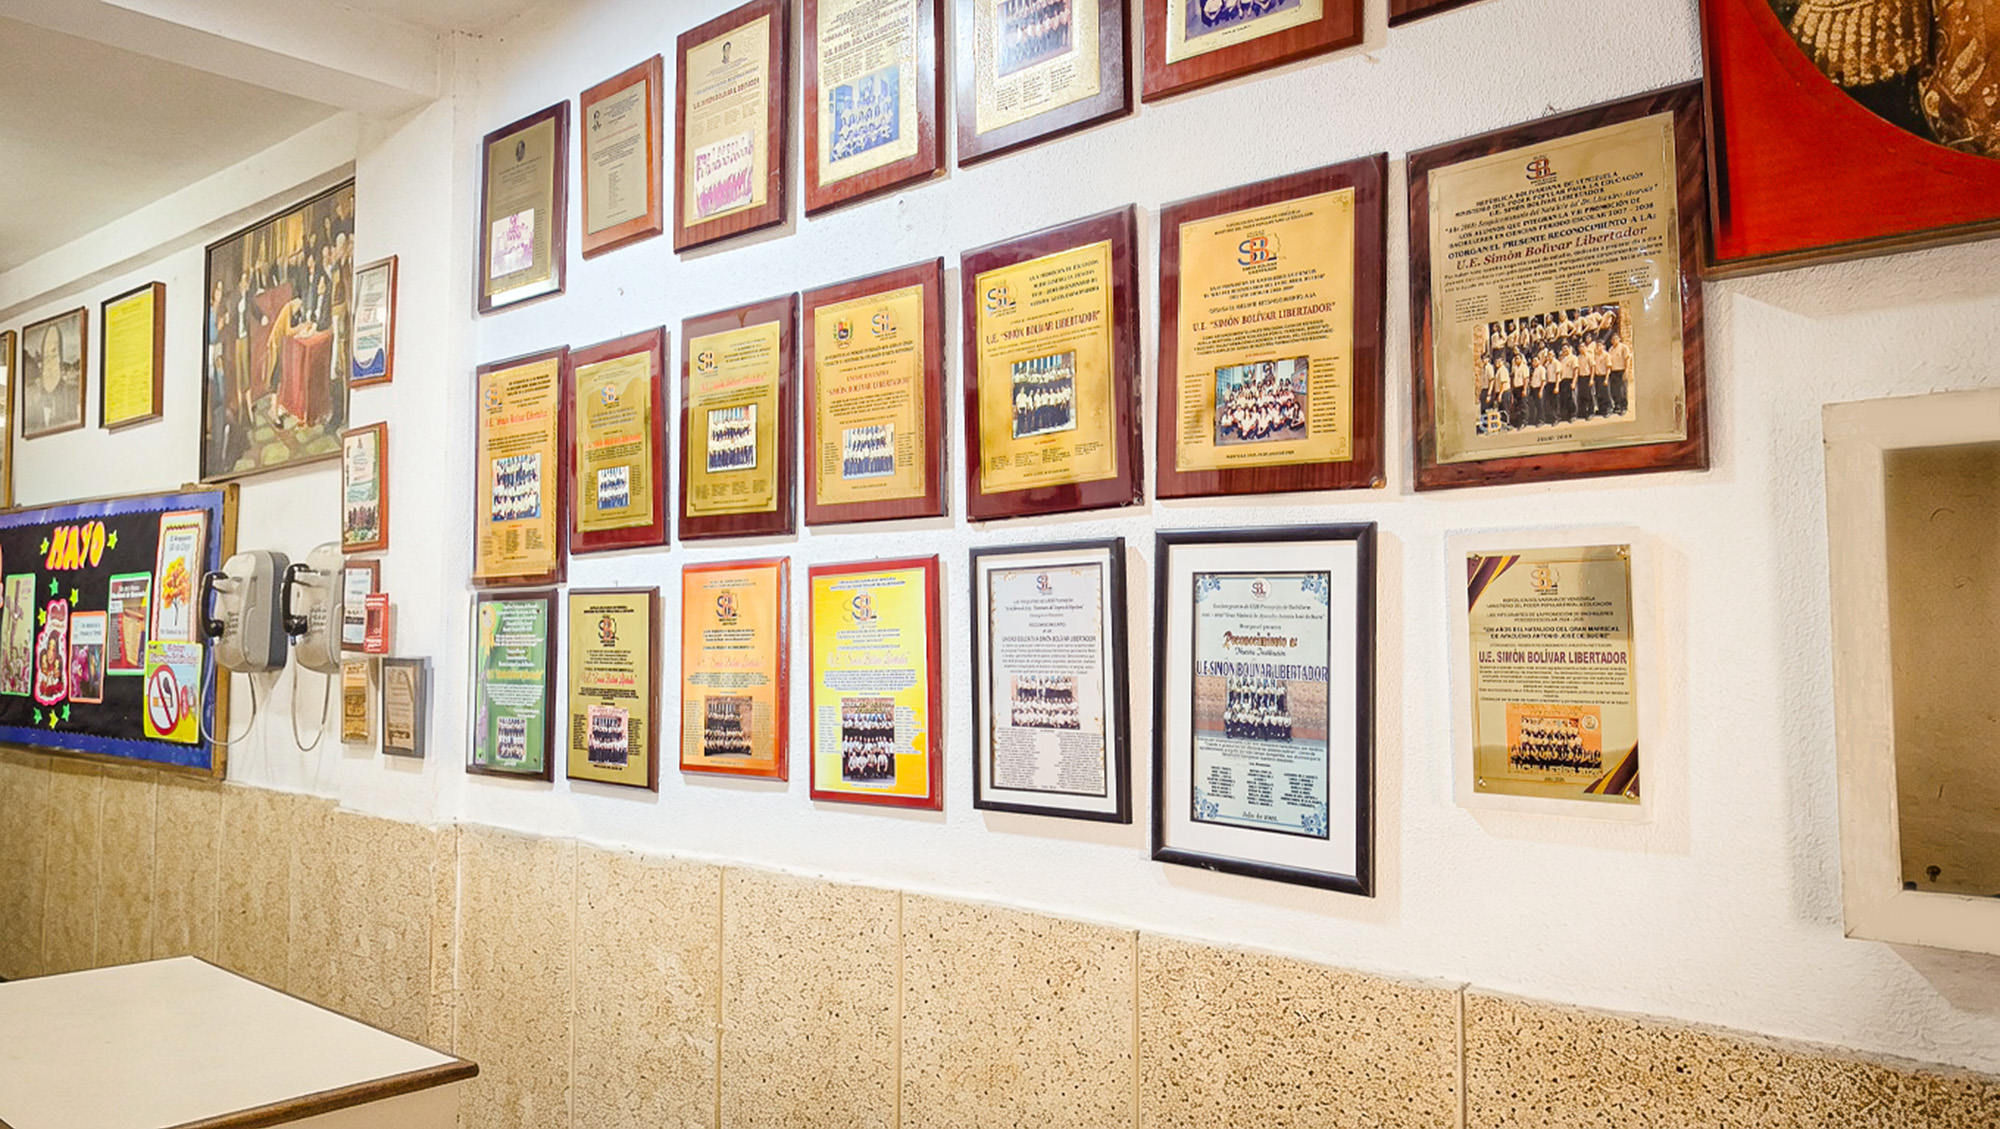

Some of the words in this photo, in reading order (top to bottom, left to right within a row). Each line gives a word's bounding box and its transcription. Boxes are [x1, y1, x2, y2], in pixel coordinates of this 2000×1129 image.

[1631, 215, 1637, 224] A
[1457, 256, 1480, 270] U.E.
[1575, 222, 1648, 249] Libertador
[45, 521, 106, 570] MAYO
[1478, 651, 1495, 663] U.E.
[1496, 648, 1525, 663] SIMÓN
[1527, 648, 1566, 663] BOLÍVAR
[1568, 651, 1627, 664] LIBERTADOR
